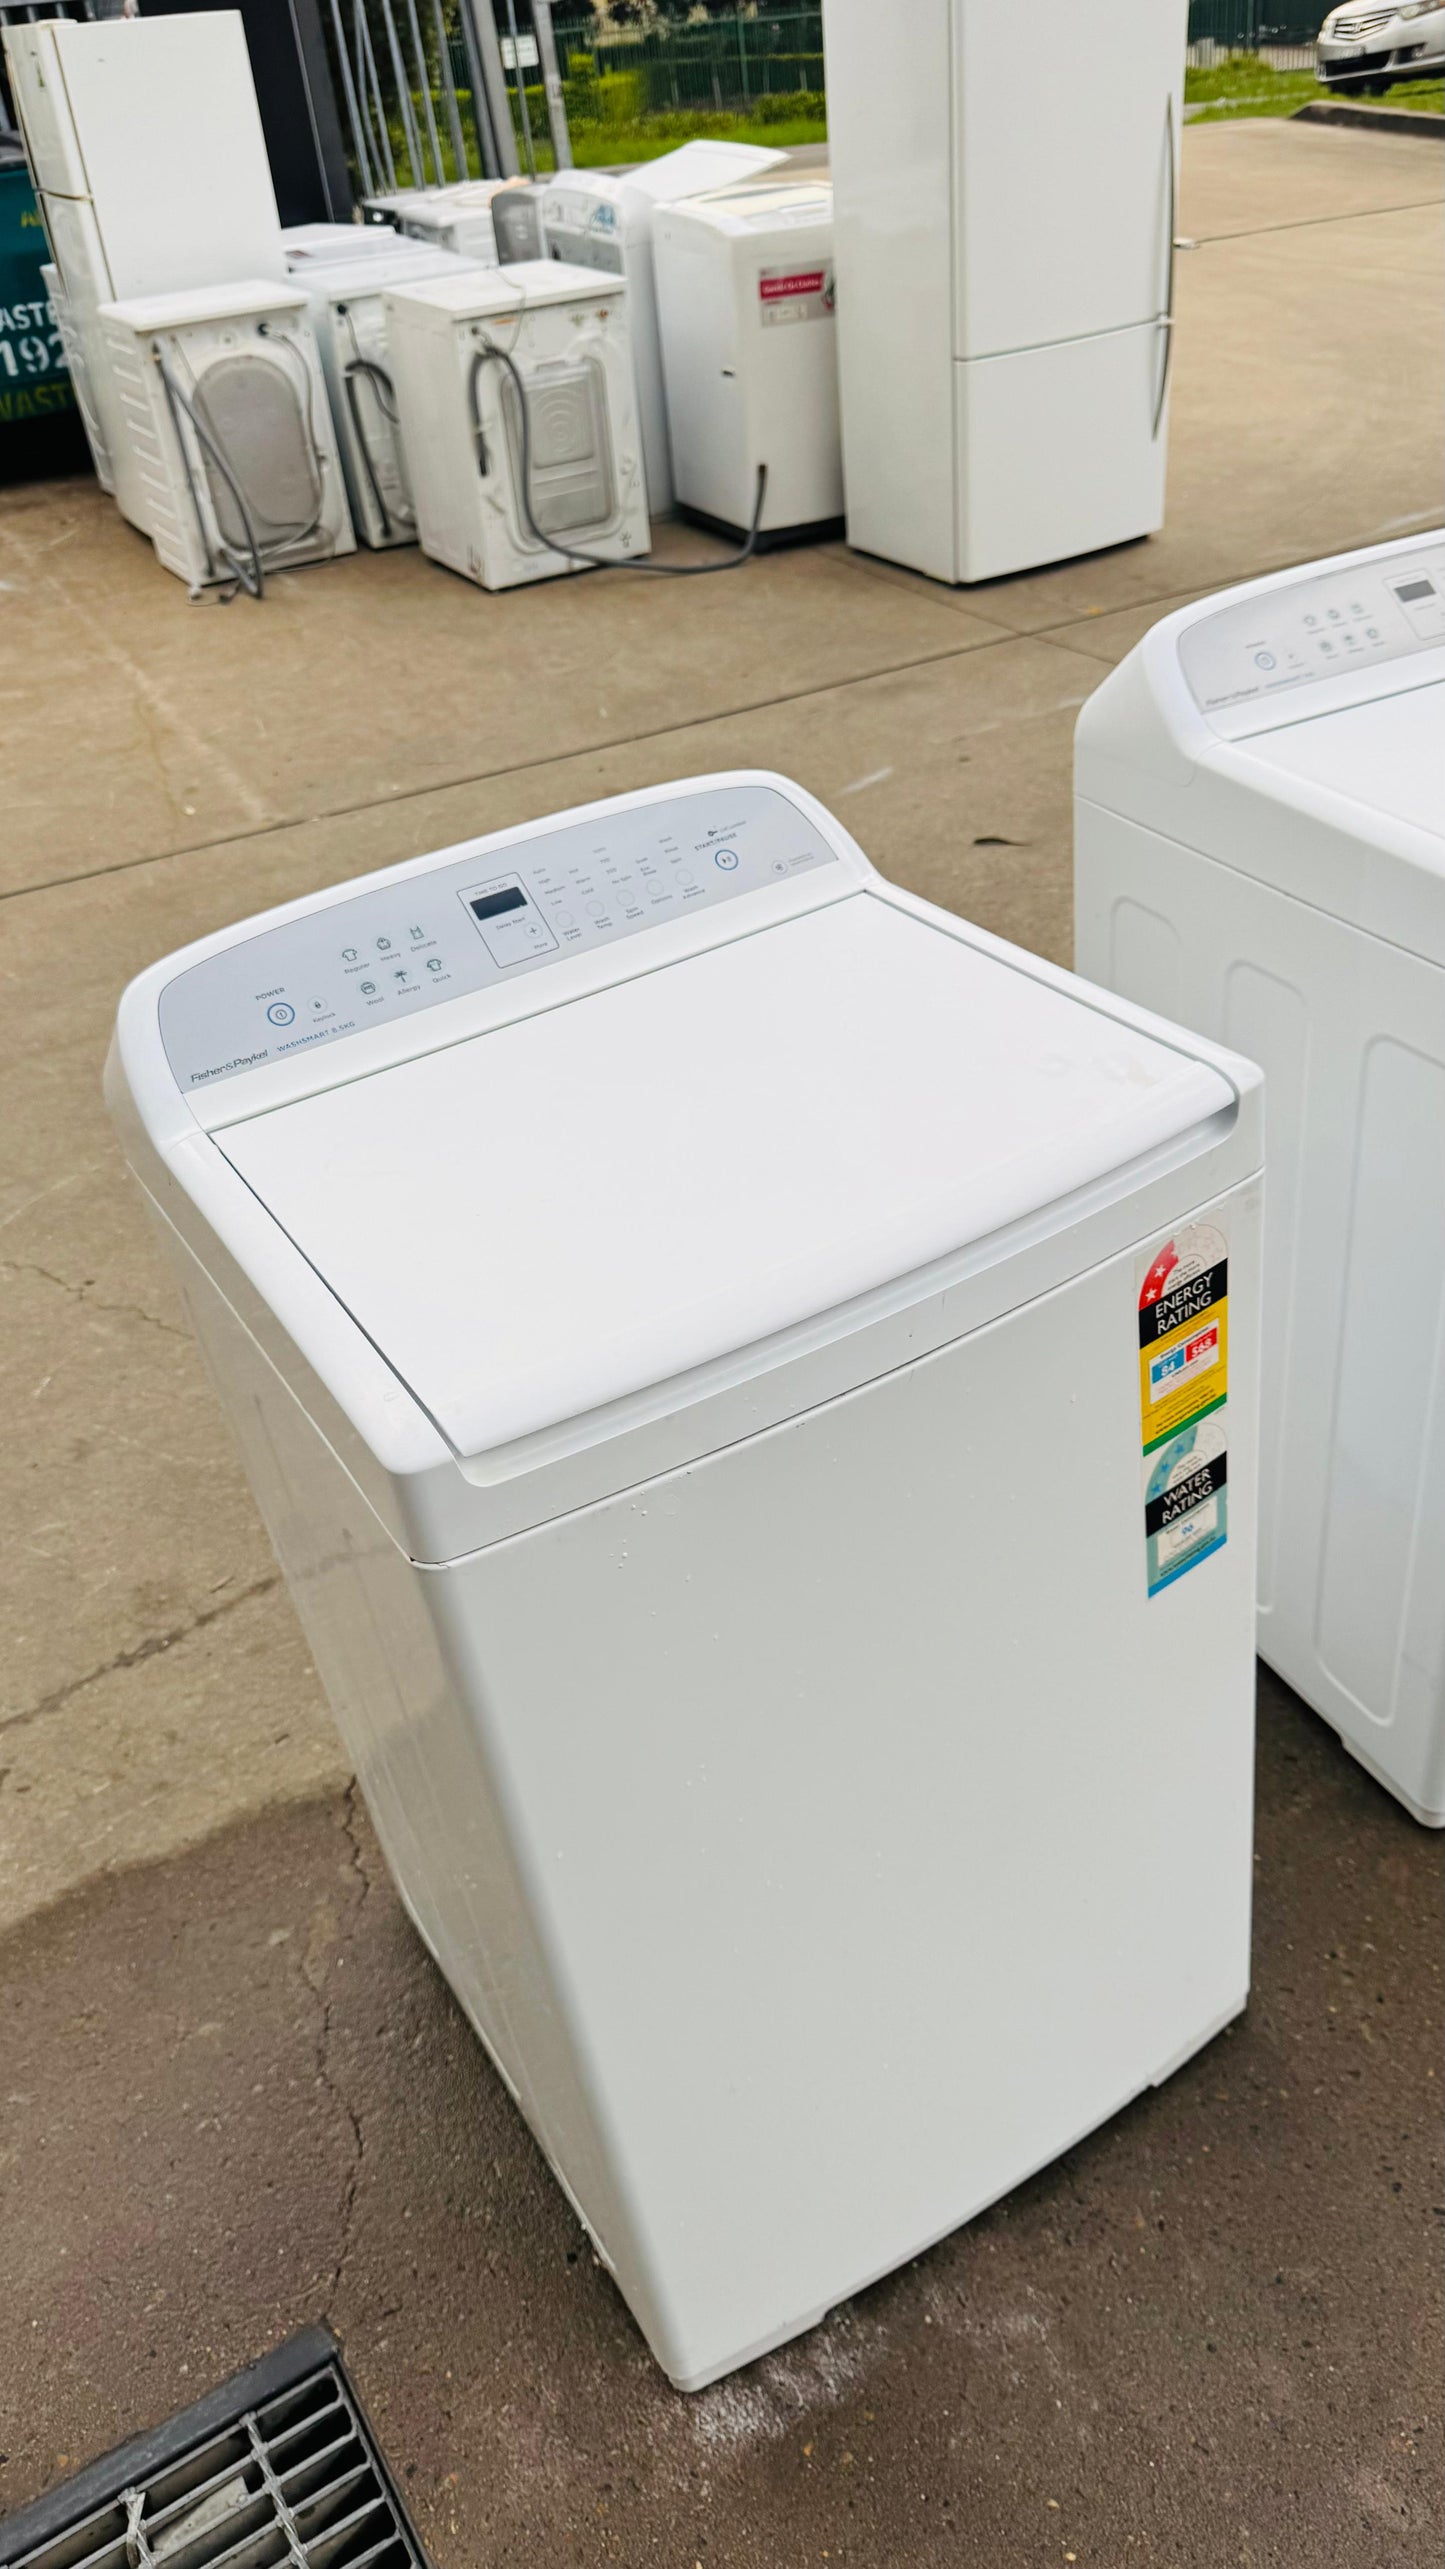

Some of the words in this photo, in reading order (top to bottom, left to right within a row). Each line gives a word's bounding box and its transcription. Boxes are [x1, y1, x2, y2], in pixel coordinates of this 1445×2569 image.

[255, 987, 286, 1001] POWER
[190, 1049, 269, 1083] Fisher&Paykel
[276, 1029, 330, 1053] WASHSMART
[1155, 1272, 1214, 1319] ENERGY
[1157, 1291, 1212, 1335] RATING
[1162, 1481, 1213, 1524] RATING
[1163, 1468, 1211, 1506] WATER
